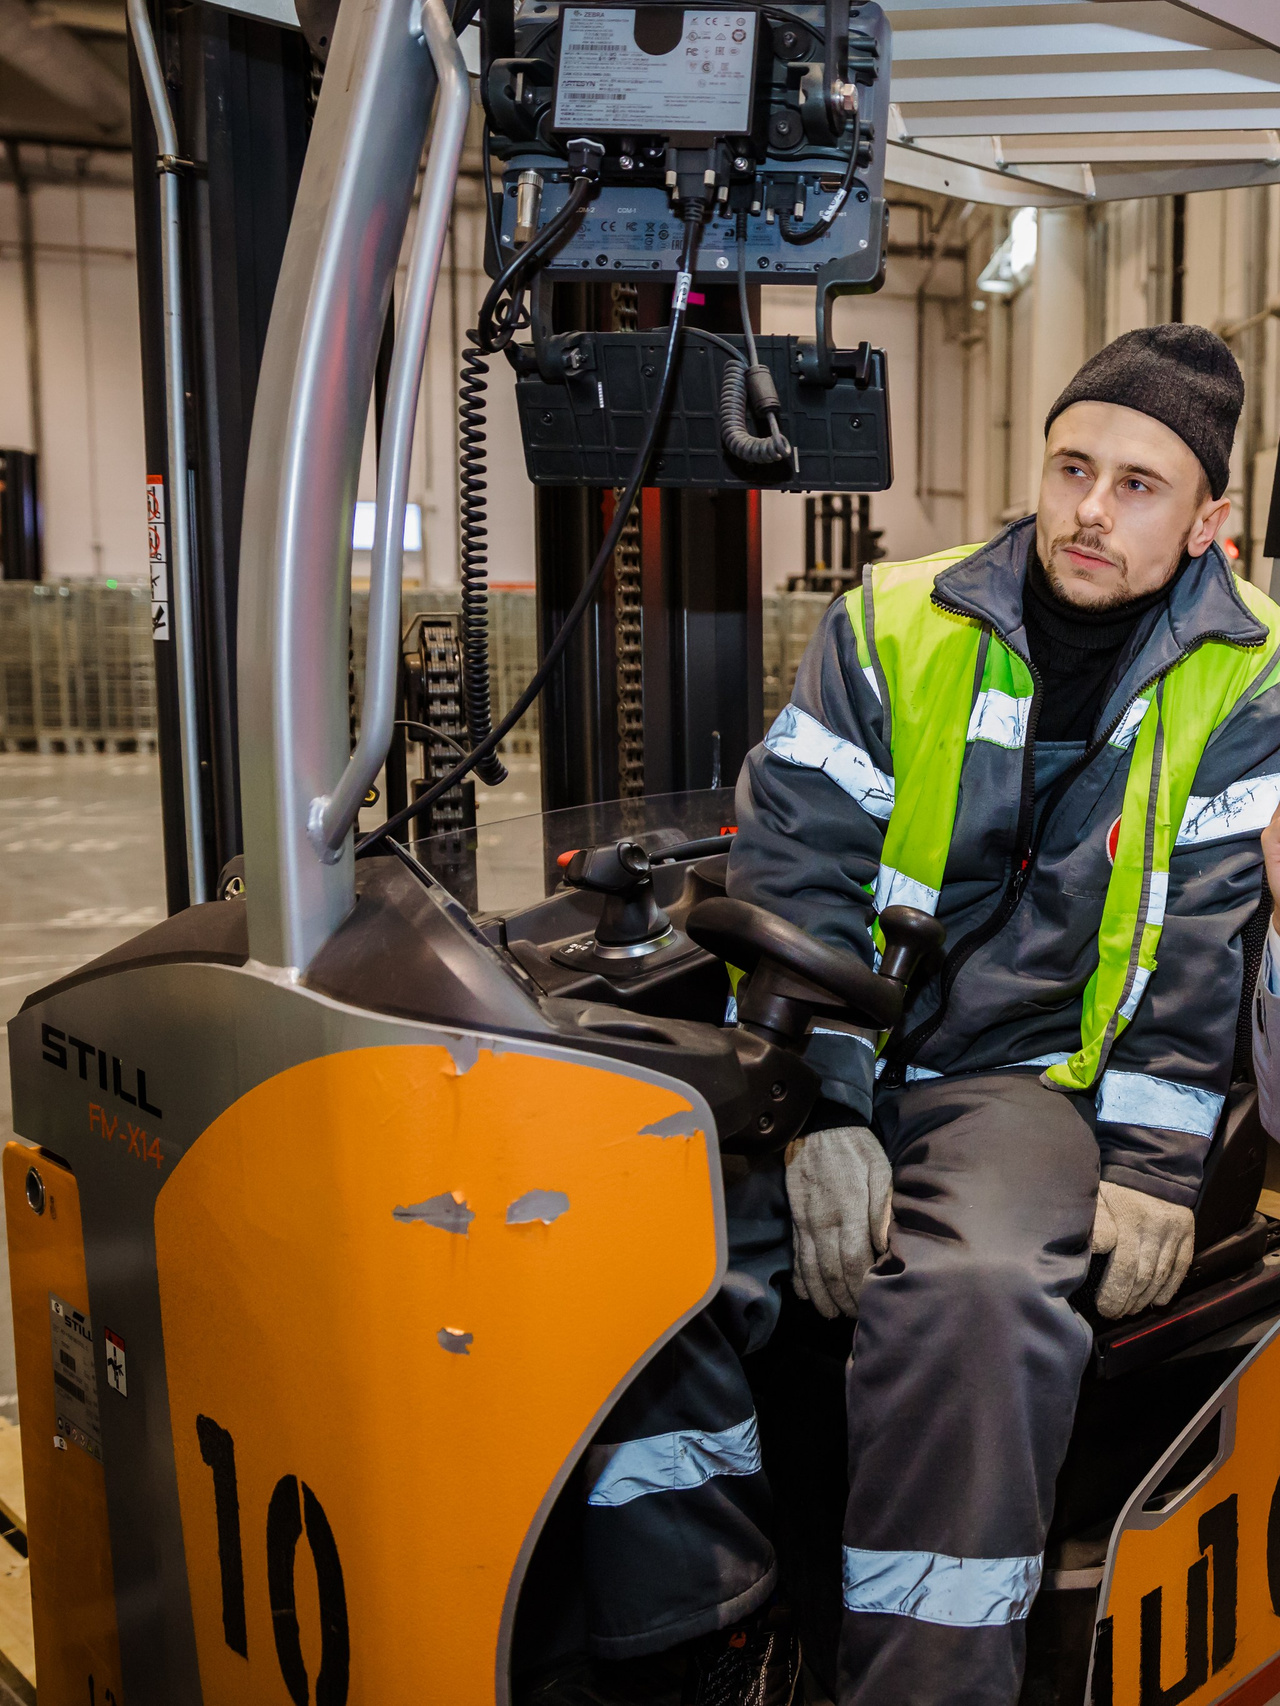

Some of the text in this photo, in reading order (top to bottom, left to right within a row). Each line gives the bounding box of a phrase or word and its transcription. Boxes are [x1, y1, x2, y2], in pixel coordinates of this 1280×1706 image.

[41, 1022, 163, 1120] STILL
[64, 1314, 94, 1342] STILL
[195, 1413, 351, 1706] 10
